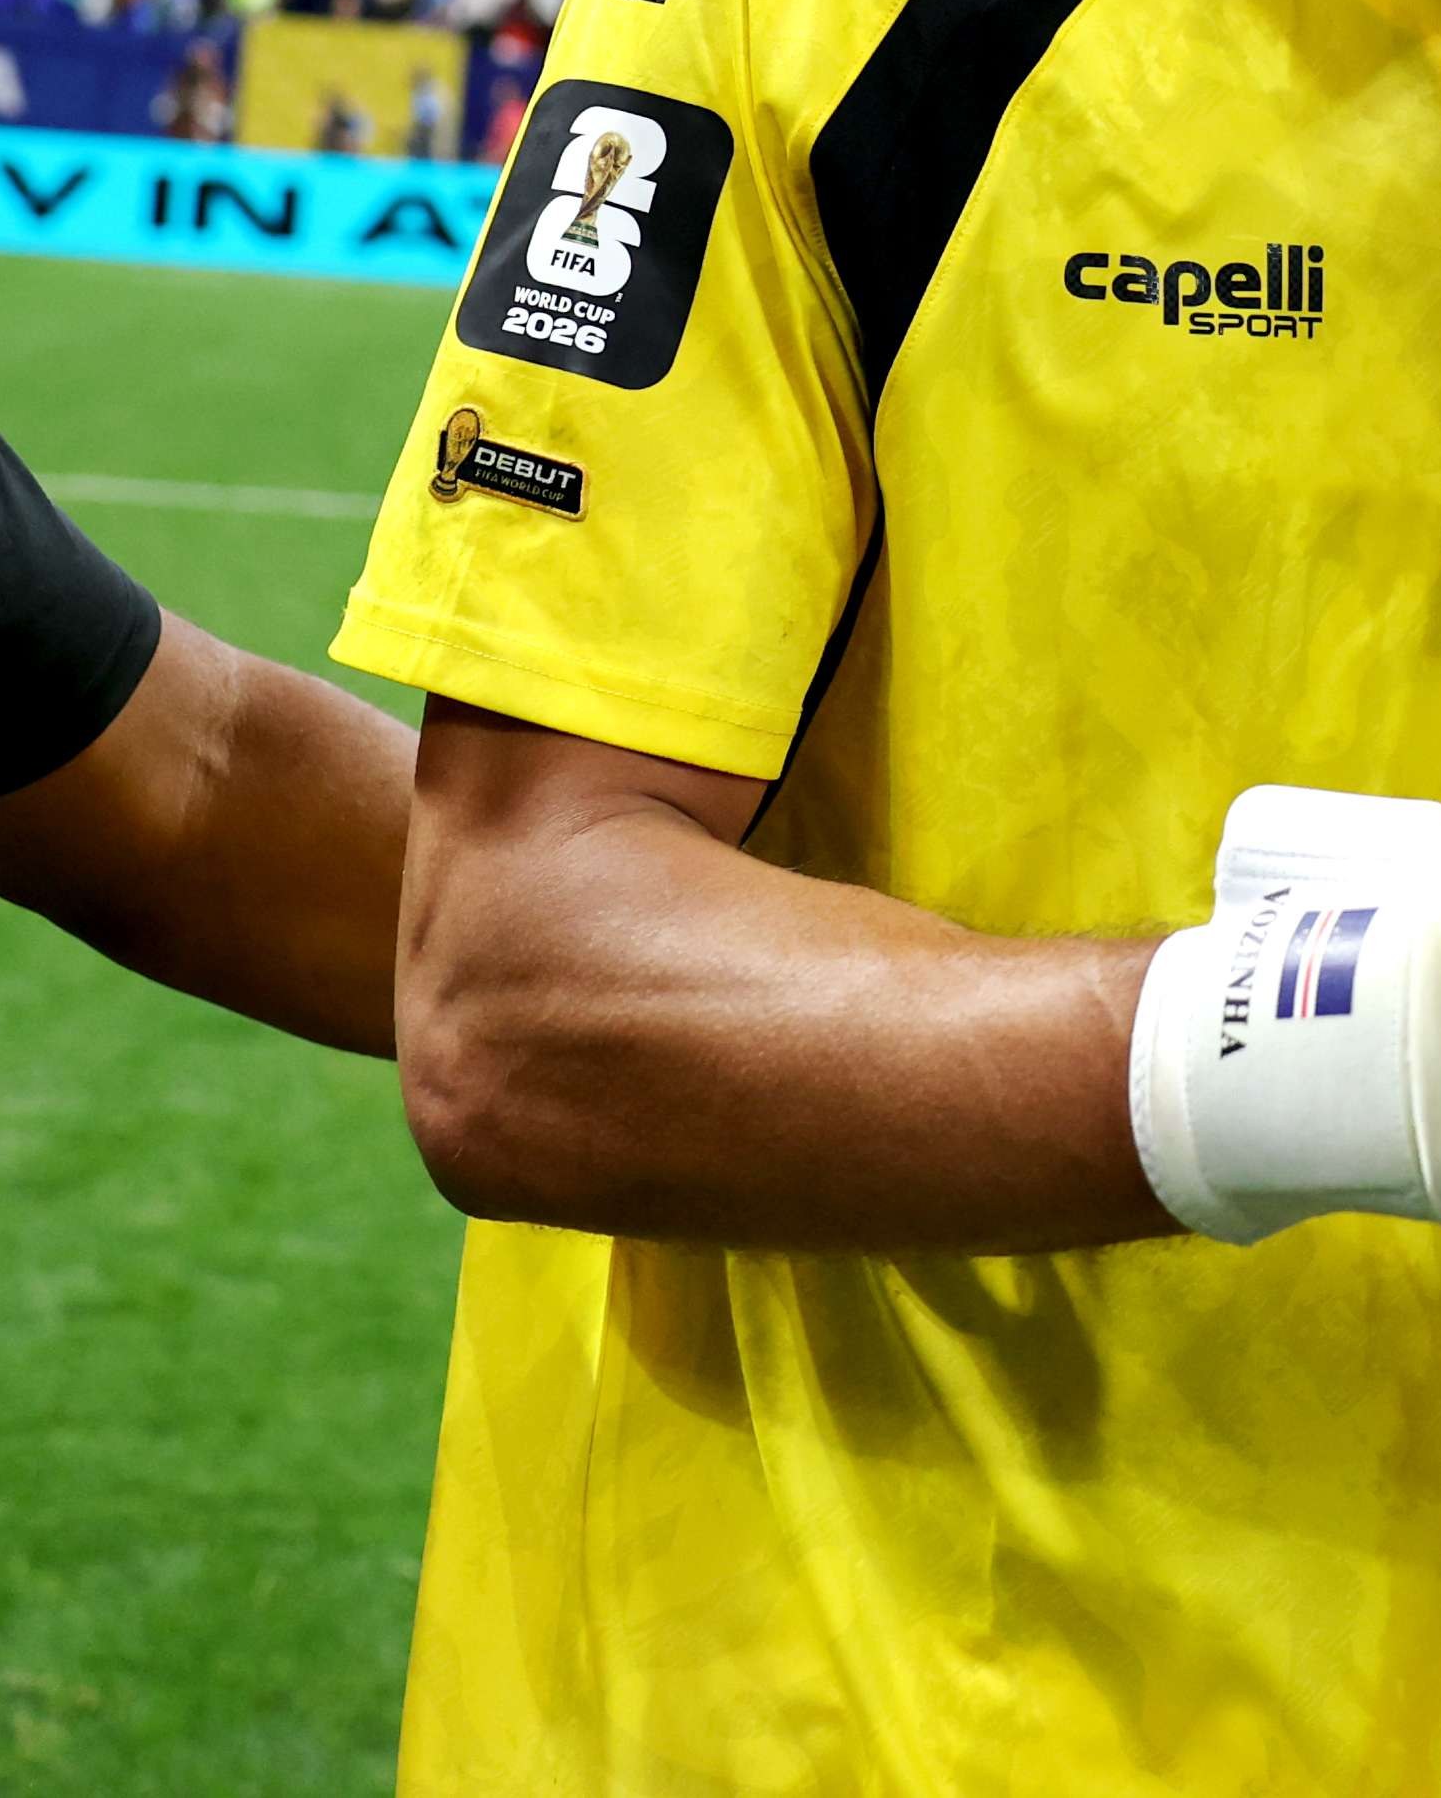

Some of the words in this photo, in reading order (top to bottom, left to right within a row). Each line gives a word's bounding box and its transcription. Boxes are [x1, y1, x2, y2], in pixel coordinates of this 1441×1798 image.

[152, 177, 295, 236] IN
[362, 196, 489, 250] A
[550, 249, 596, 277] FIFA
[1064, 243, 1324, 325] capelli
[513, 285, 572, 313] WORLD
[573, 301, 616, 326] CUP
[1189, 312, 1323, 339] SPORT
[502, 306, 608, 354] 2026
[474, 446, 577, 489] DEBUT
[474, 468, 499, 483] FIFA
[500, 475, 541, 496] WORLD
[541, 488, 565, 502] CUP
[1219, 886, 1291, 1060] VOZINHA
